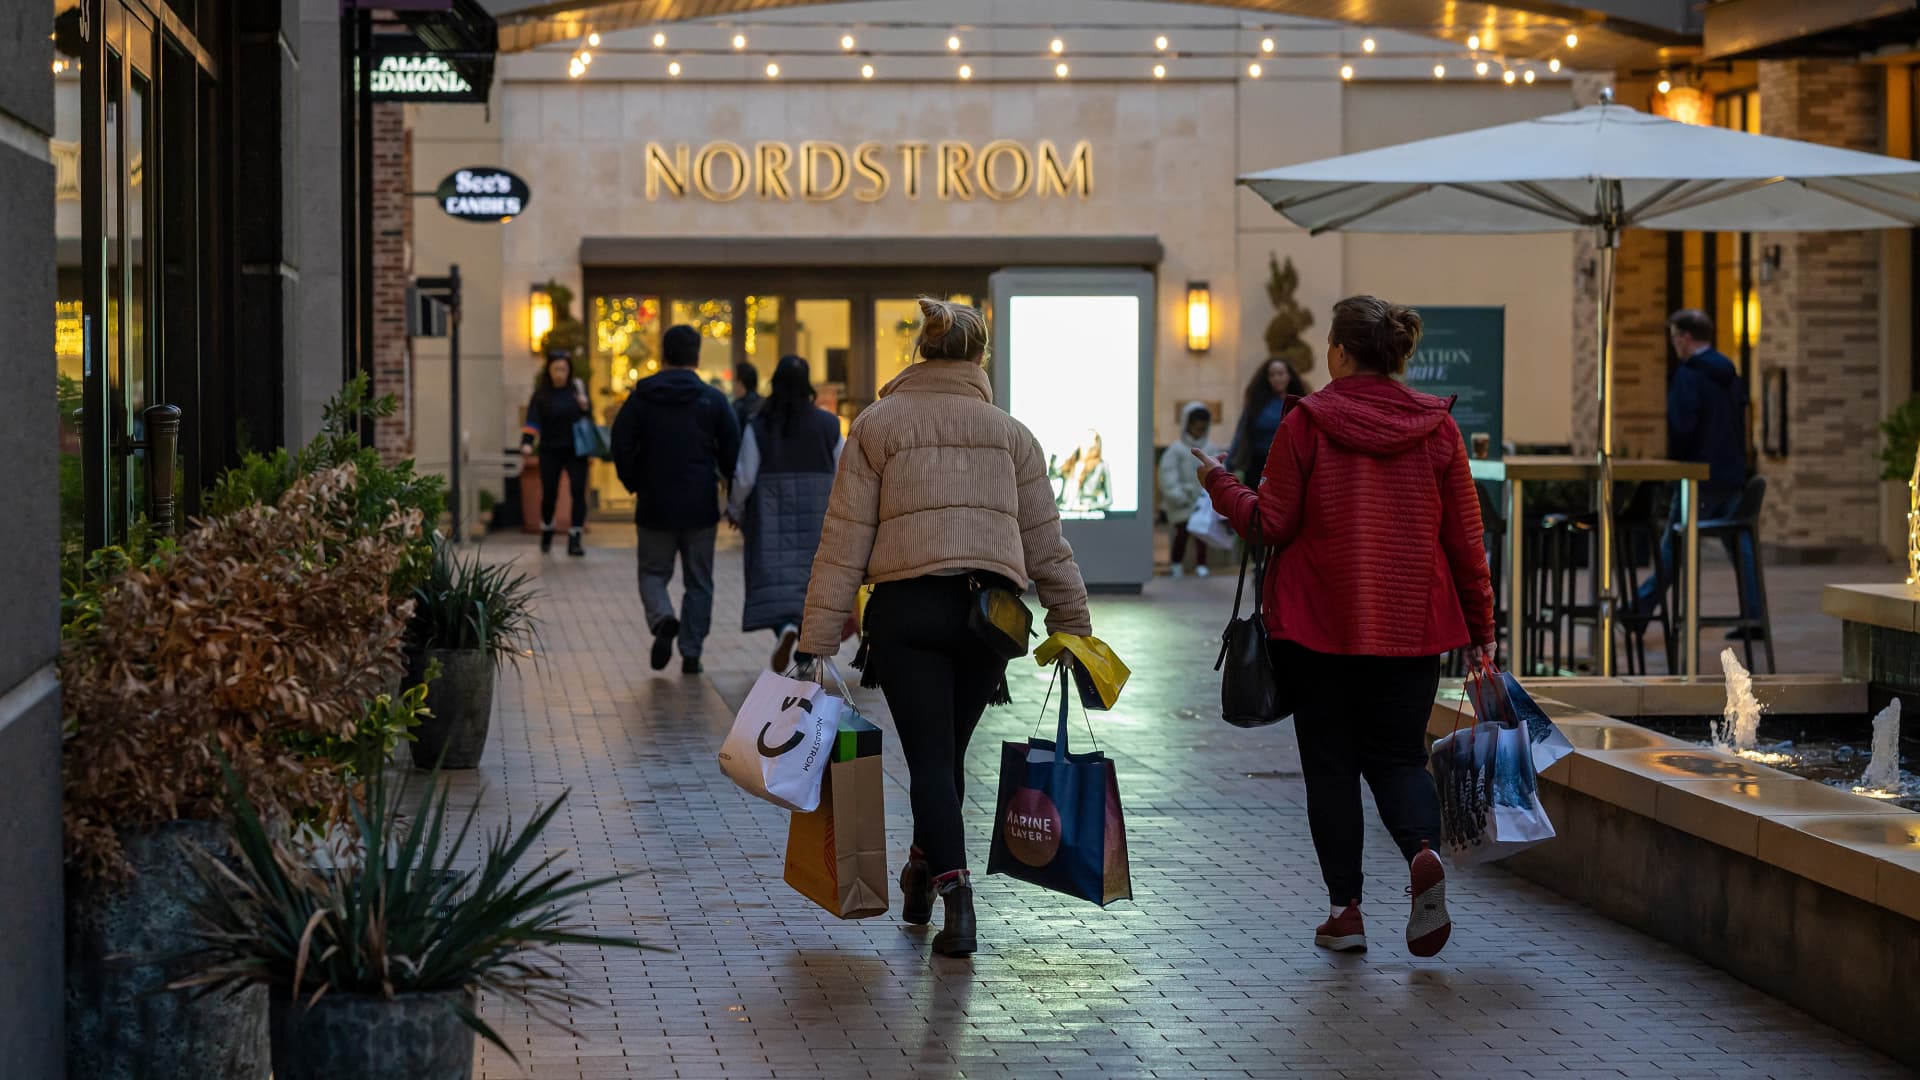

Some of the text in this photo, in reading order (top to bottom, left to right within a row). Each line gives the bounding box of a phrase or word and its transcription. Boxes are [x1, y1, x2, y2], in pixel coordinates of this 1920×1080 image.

[645, 139, 1094, 201] NORDSTROM
[456, 170, 512, 194] See's
[446, 197, 521, 214] CANDIES
[803, 717, 823, 772] NORDSTROM
[1007, 810, 1052, 833] MARINE
[1011, 826, 1043, 842] LAYER
